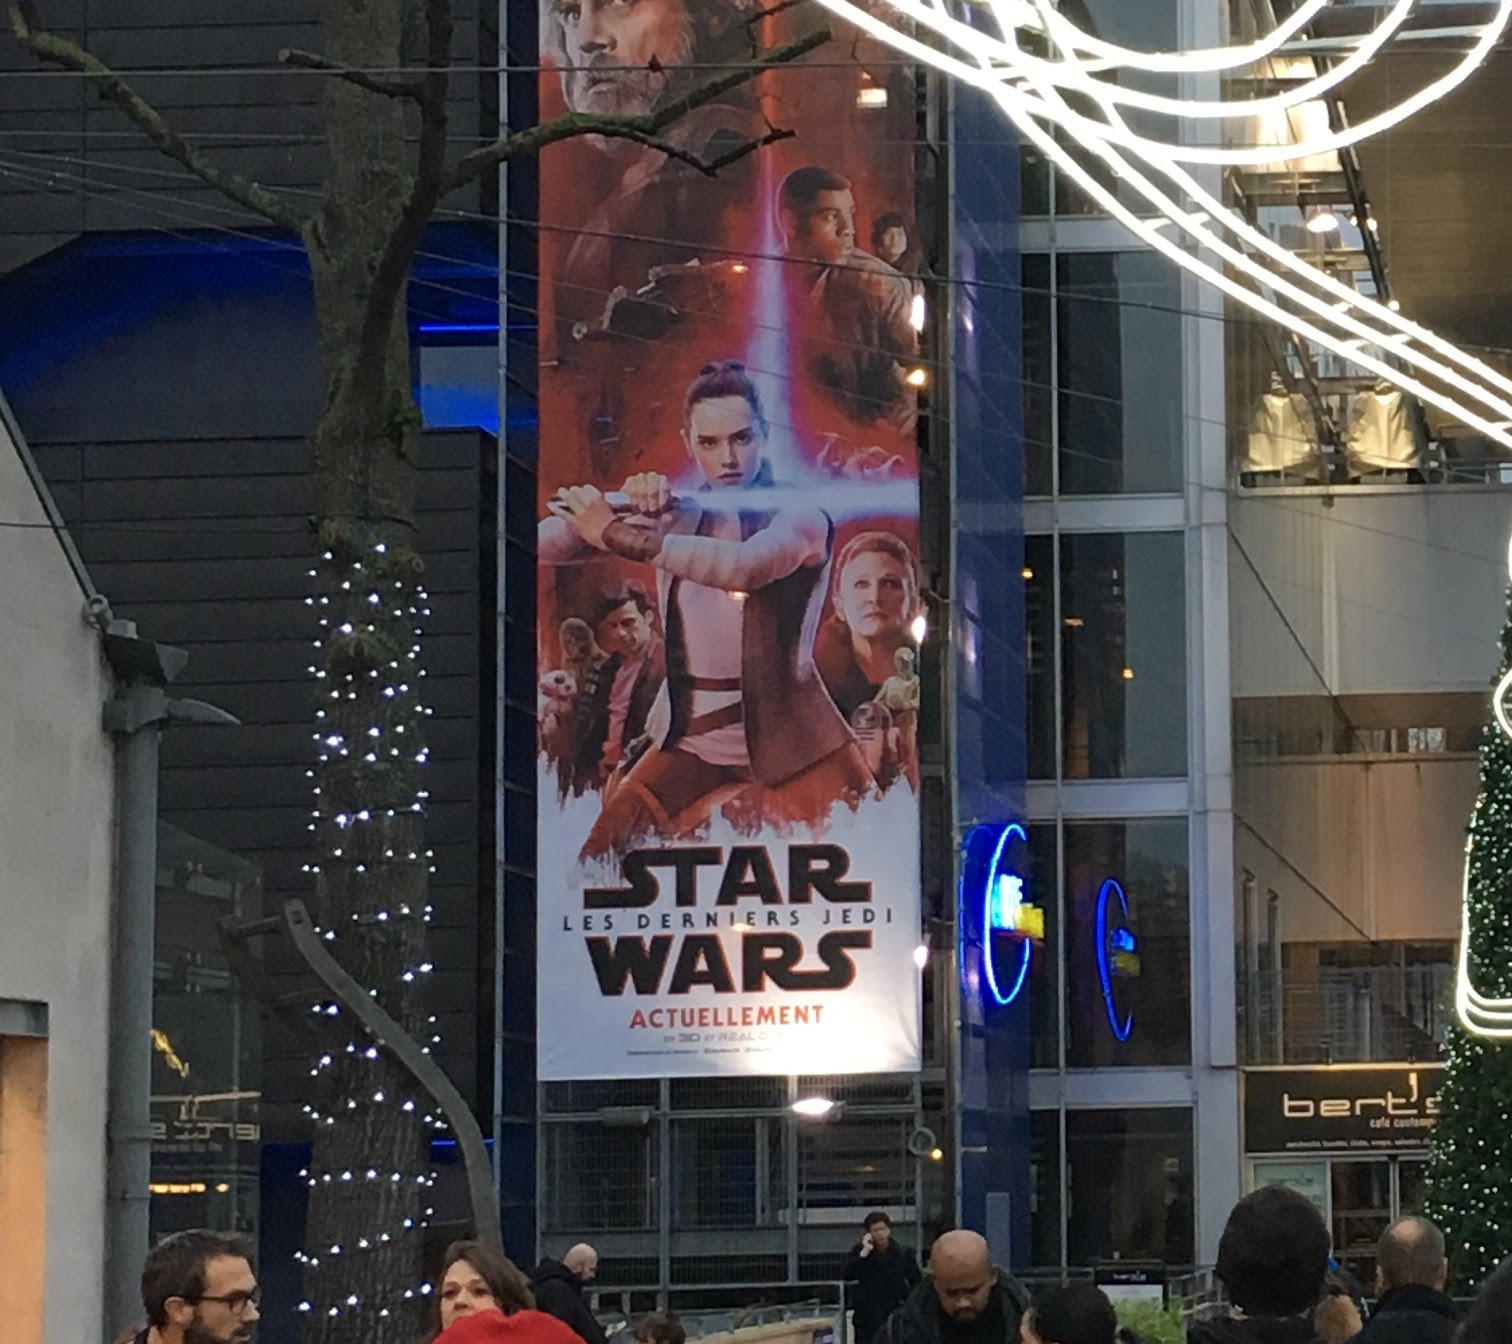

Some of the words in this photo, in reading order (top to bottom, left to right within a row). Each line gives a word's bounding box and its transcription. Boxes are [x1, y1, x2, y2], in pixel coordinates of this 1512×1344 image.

[583, 843, 872, 909] STAR
[562, 915, 614, 931] LES
[637, 908, 800, 929] DERNIERS
[822, 907, 893, 924] JEDI
[584, 929, 872, 996] WARS
[629, 1004, 824, 1029] ACTUELLEMENT
